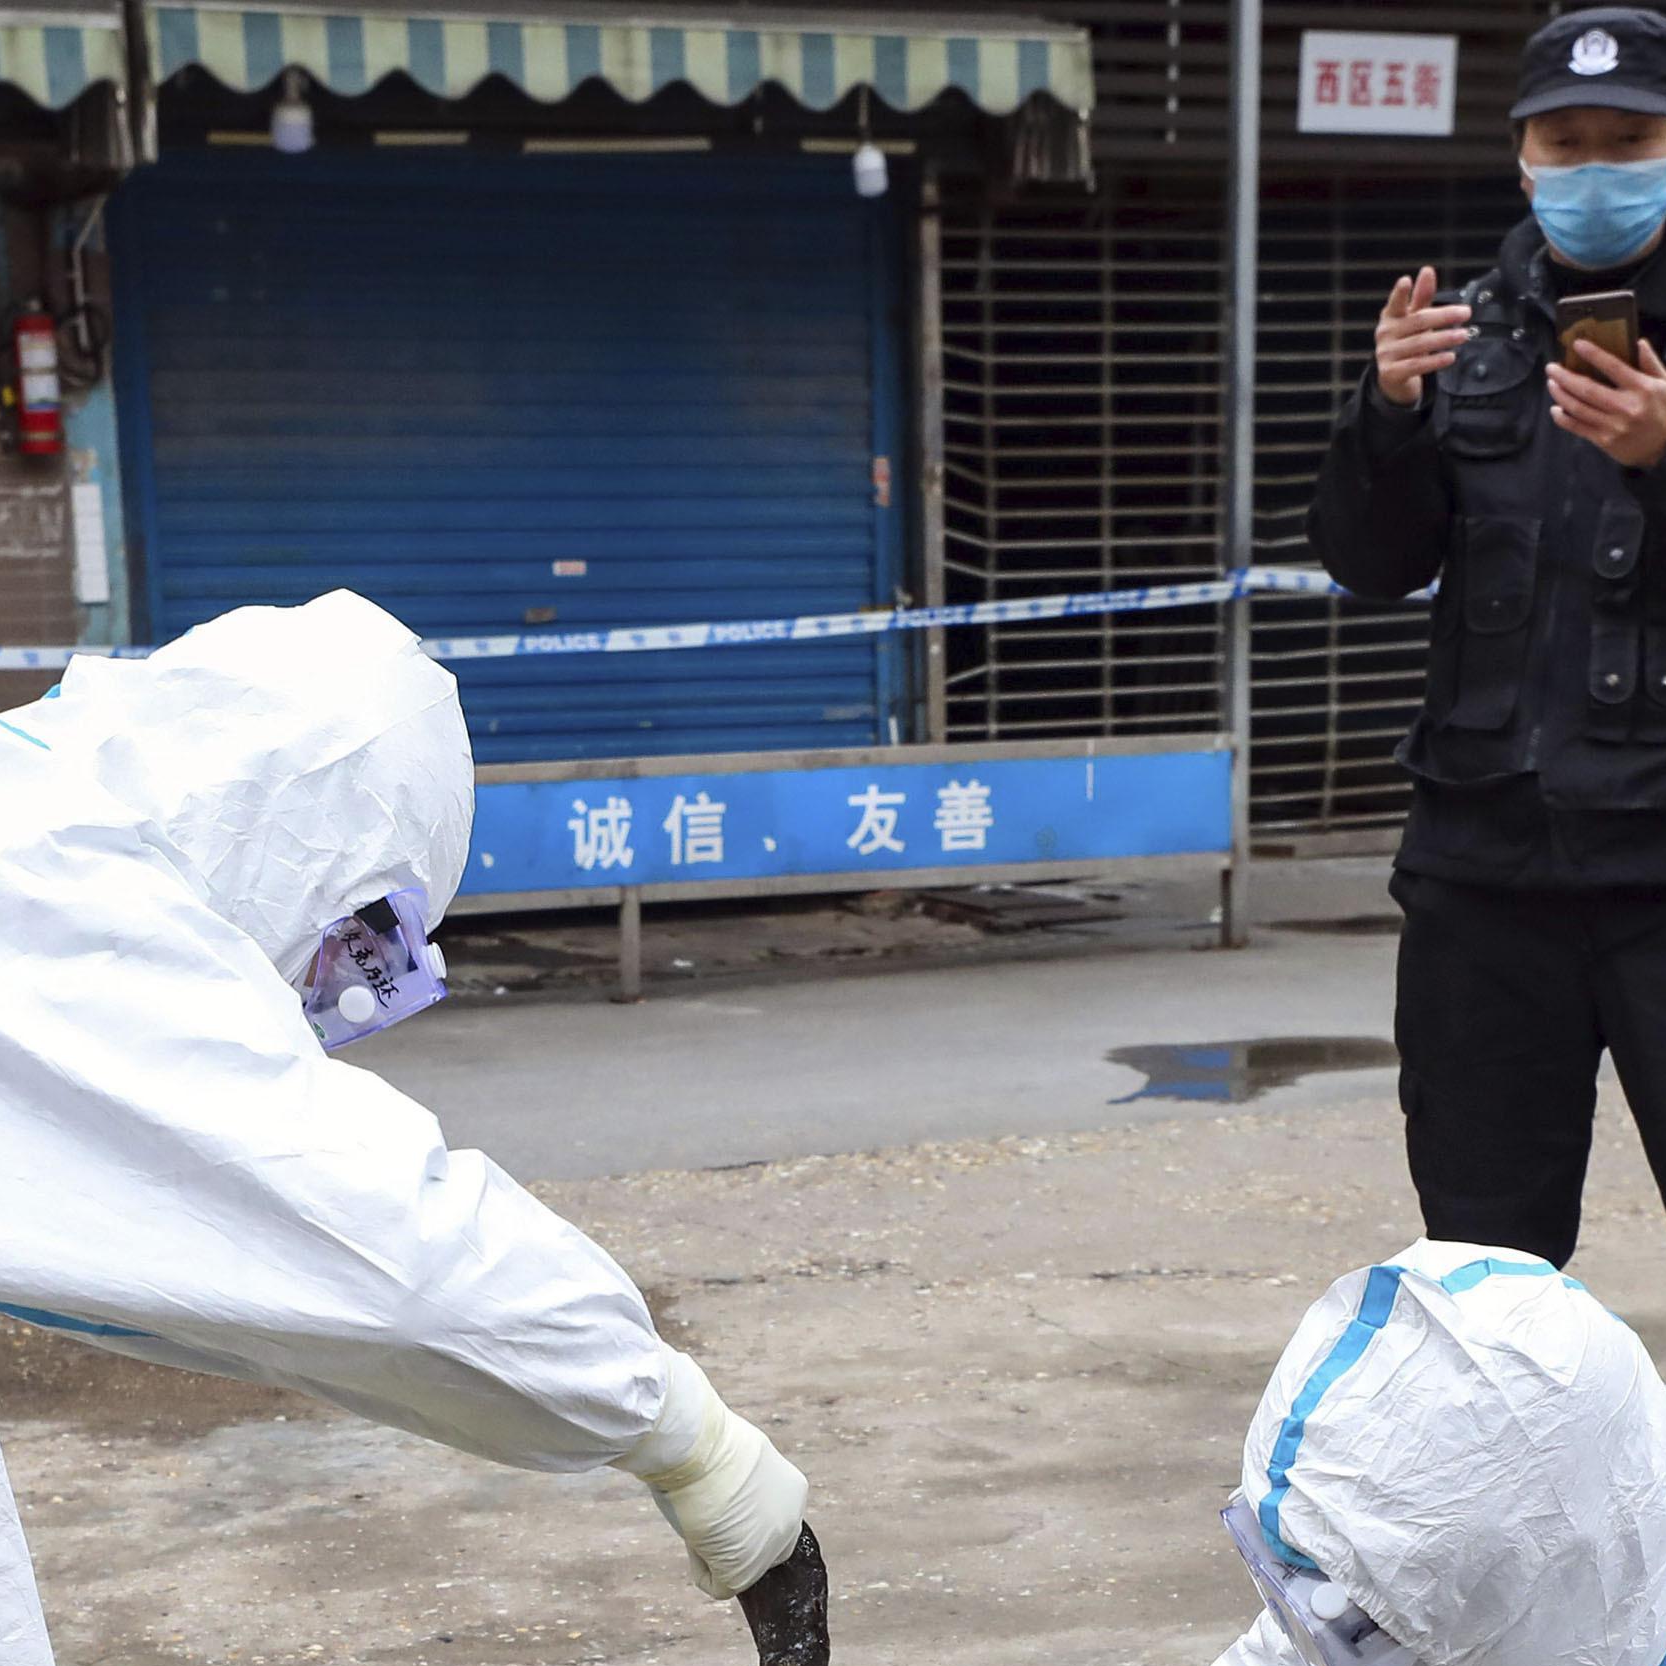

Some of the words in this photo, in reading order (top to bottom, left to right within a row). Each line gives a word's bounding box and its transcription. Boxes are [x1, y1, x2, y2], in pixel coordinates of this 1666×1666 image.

[1315, 60, 1440, 110] 西区五街
[524, 632, 600, 652] POLICE
[715, 619, 786, 642] POLICE
[895, 607, 966, 628] POLICE
